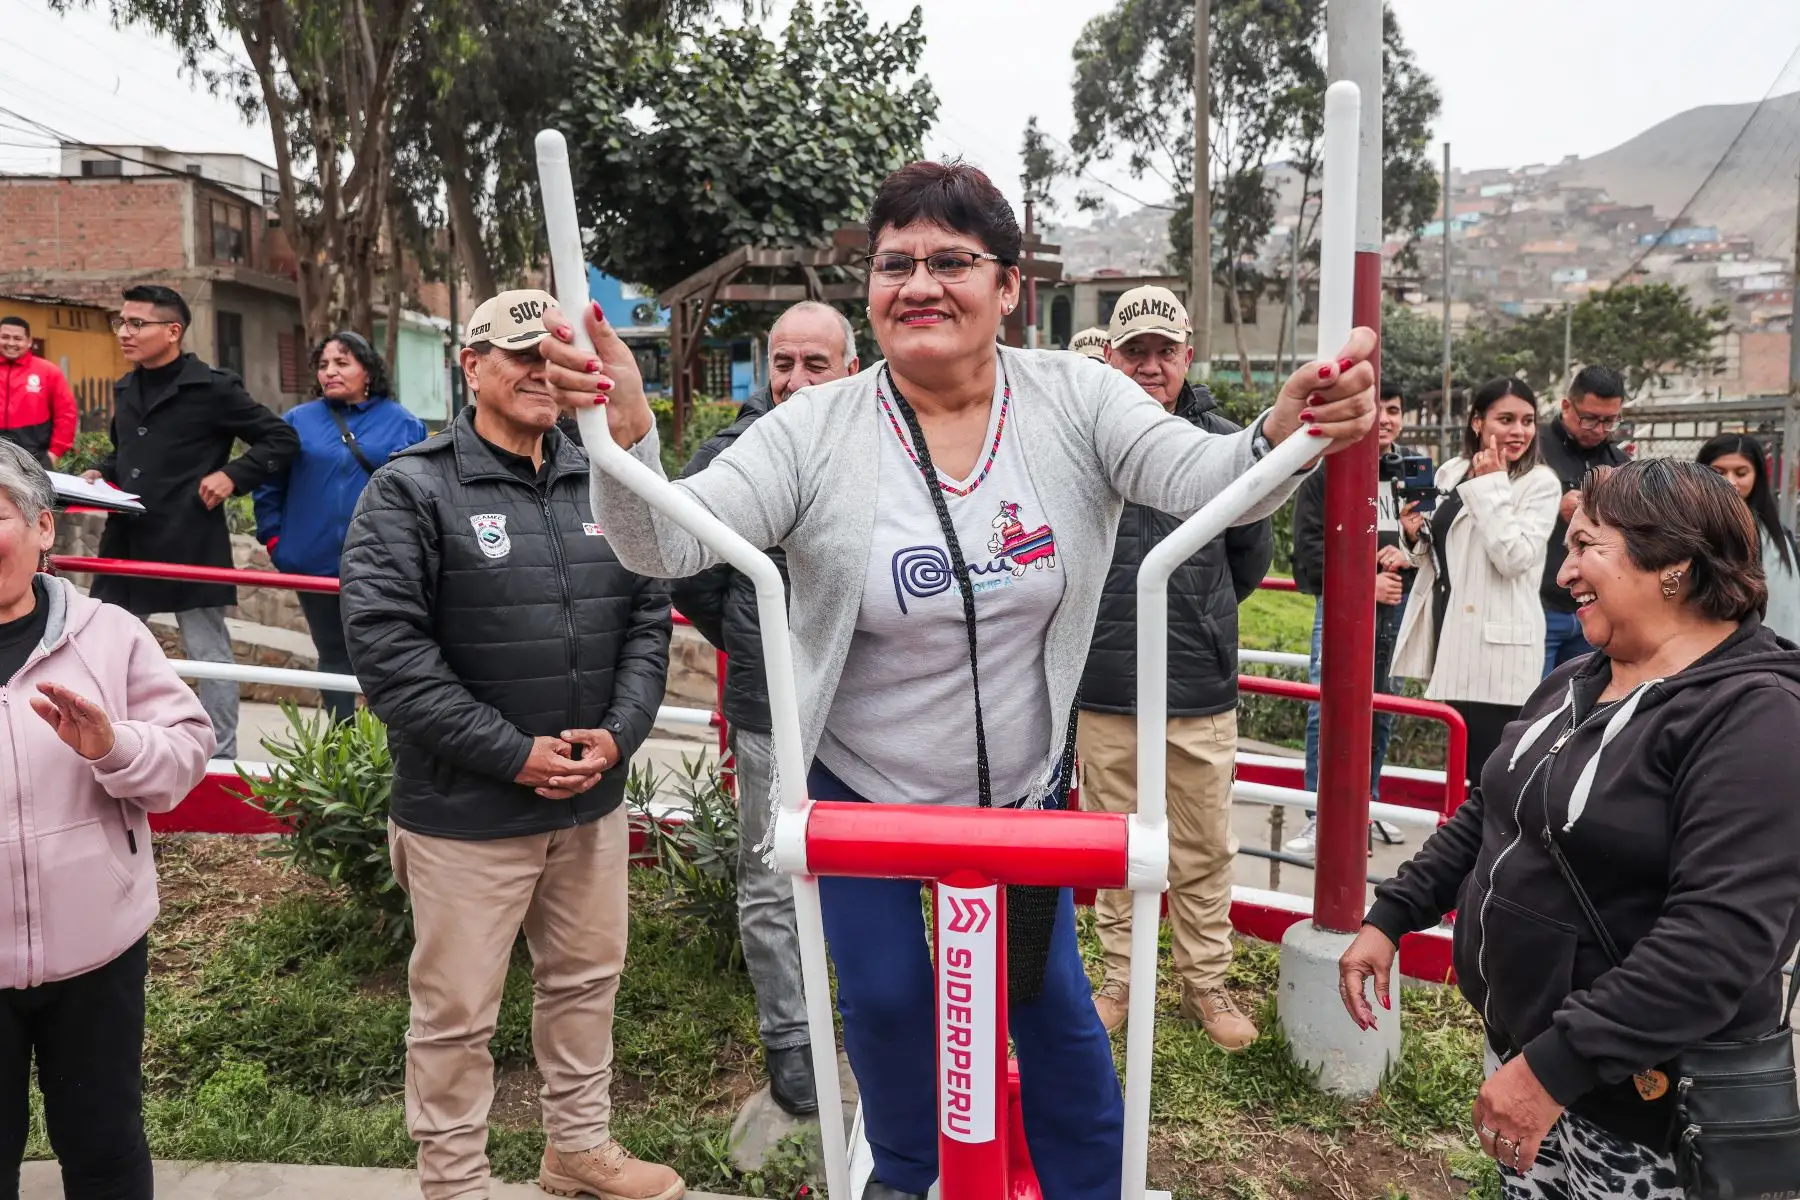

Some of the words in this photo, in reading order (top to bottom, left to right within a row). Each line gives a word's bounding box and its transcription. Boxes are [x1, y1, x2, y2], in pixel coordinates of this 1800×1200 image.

[509, 300, 555, 324] SUC
[1118, 298, 1177, 326] SUCAMEC
[471, 322, 491, 338] PERU
[1074, 336, 1106, 350] SUCAME
[946, 947, 972, 1135] SIDERPERU
